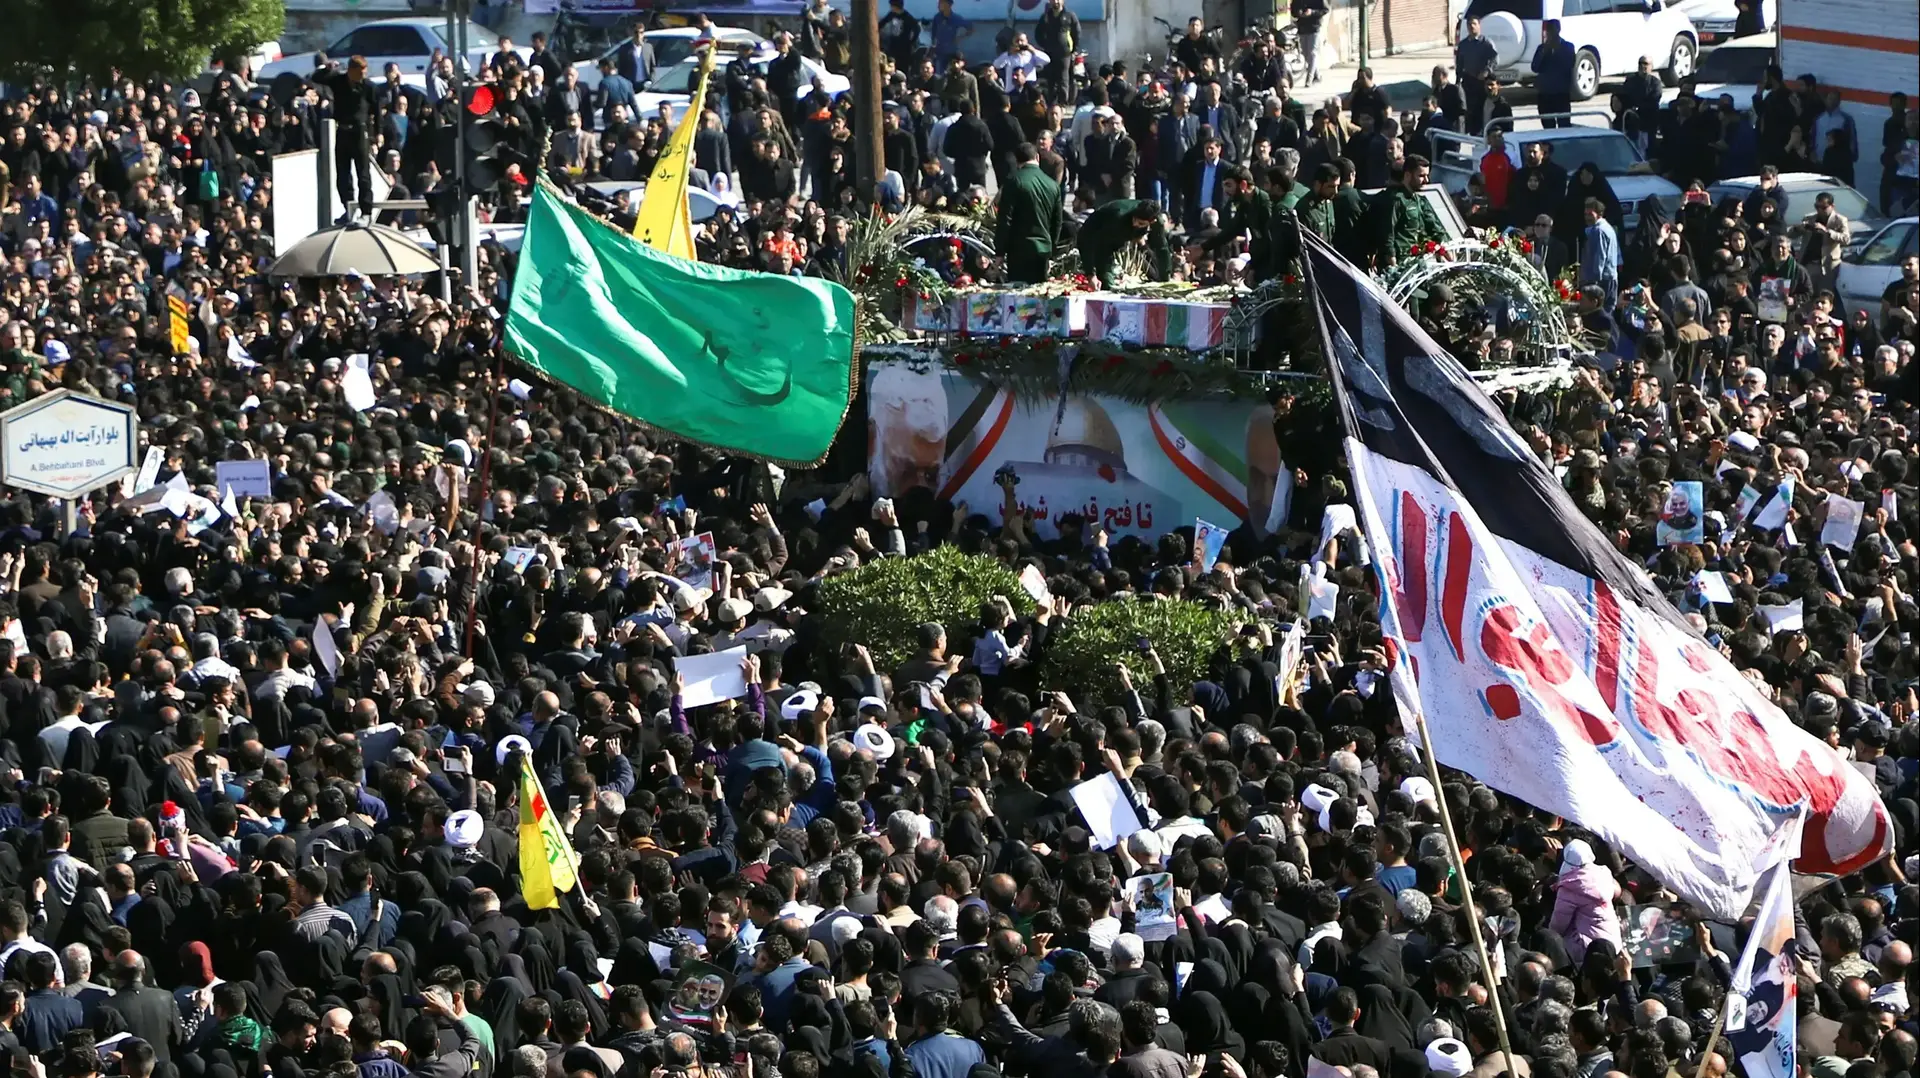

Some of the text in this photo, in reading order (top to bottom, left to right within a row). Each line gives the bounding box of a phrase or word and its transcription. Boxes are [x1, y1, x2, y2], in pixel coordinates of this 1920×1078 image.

[19, 433, 58, 452] بهبهانی
[76, 425, 97, 447] آیت
[95, 426, 119, 445] بلوار
[1104, 498, 1132, 534] فتح
[1137, 501, 1152, 529] تا
